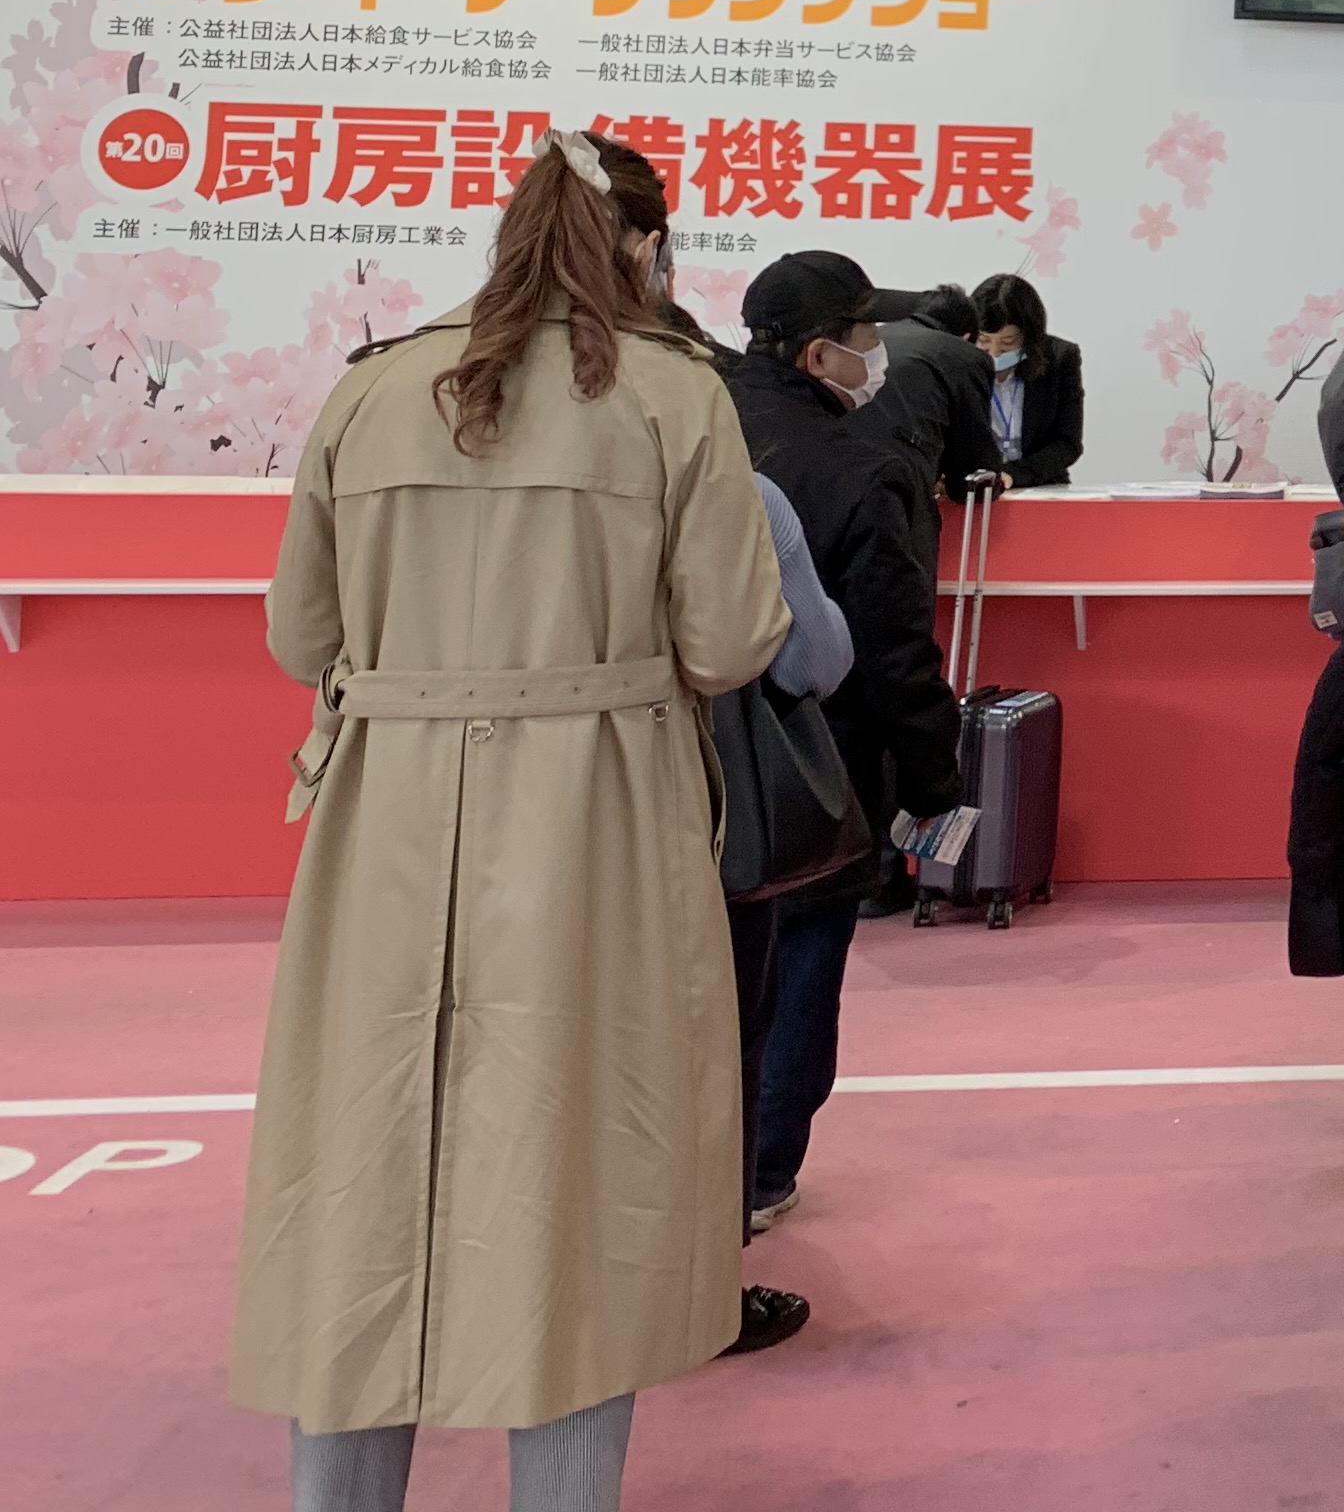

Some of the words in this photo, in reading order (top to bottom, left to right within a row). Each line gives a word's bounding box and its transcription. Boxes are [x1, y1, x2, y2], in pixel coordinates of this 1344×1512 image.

[577, 33, 918, 64] 一般社団法人日本弁当サービス協会
[178, 46, 553, 81] 公益社団法人日本メディカル給食協会
[576, 62, 838, 90] 一般社団法人日本能率協会
[105, 132, 184, 163] 第20回
